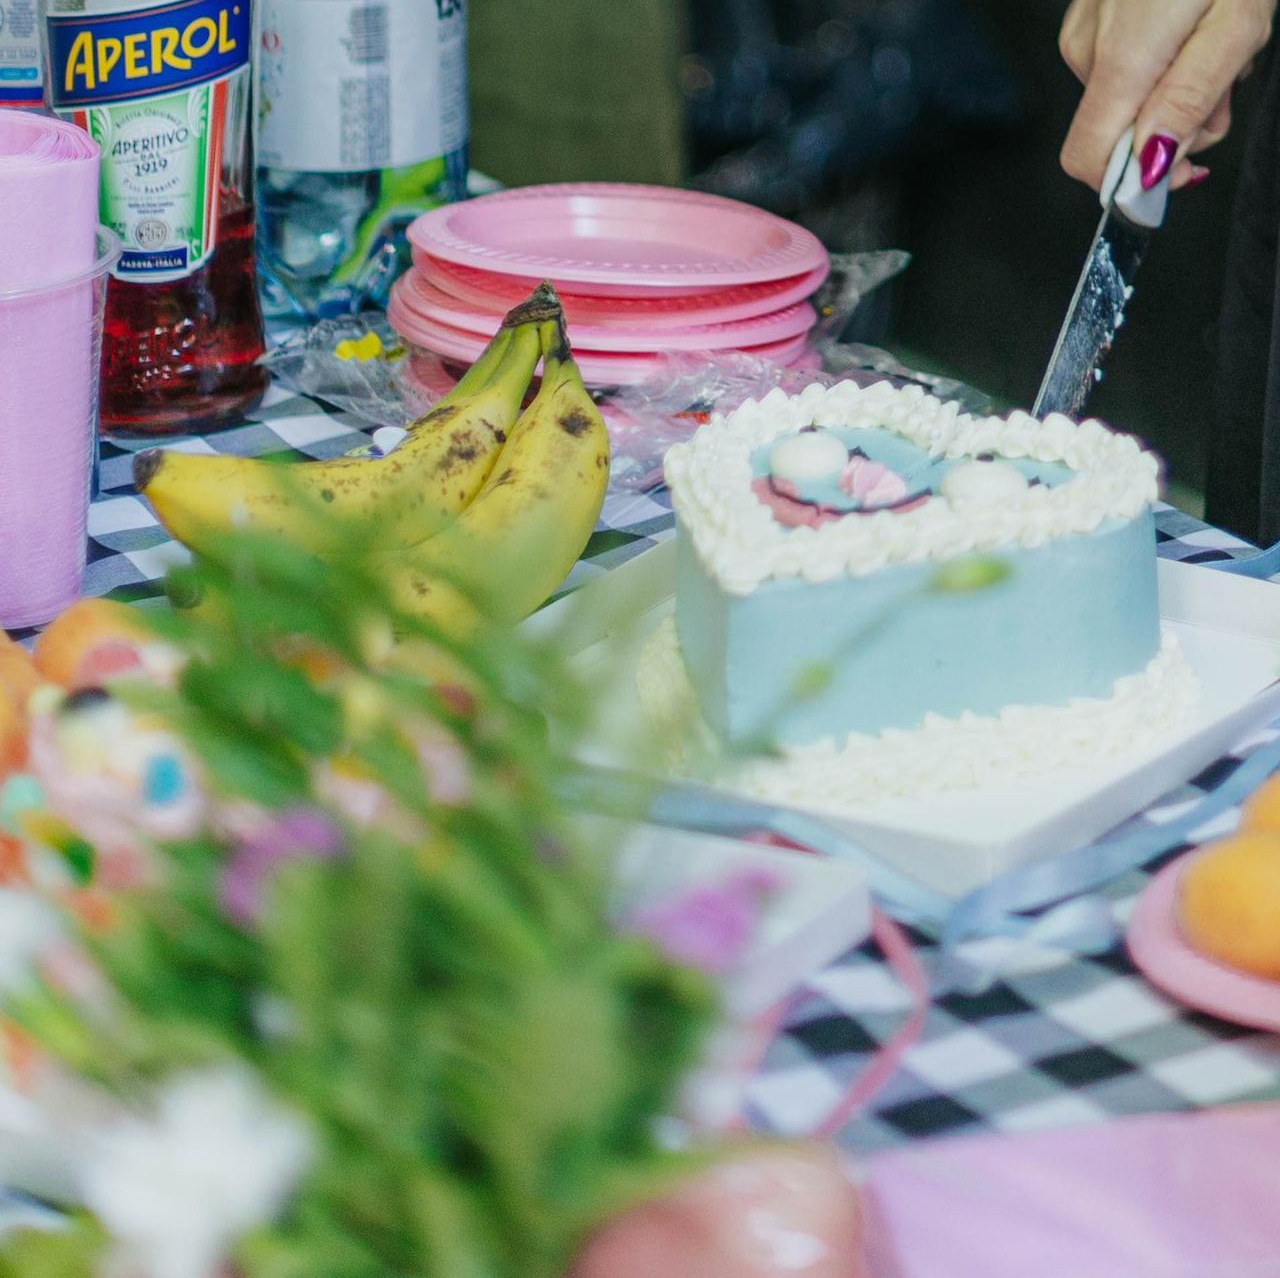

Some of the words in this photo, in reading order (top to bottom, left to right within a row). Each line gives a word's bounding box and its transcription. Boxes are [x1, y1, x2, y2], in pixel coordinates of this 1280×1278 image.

[65, 9, 236, 91] APEROL
[112, 127, 189, 157] APERITIVO
[134, 159, 168, 177] 1919
